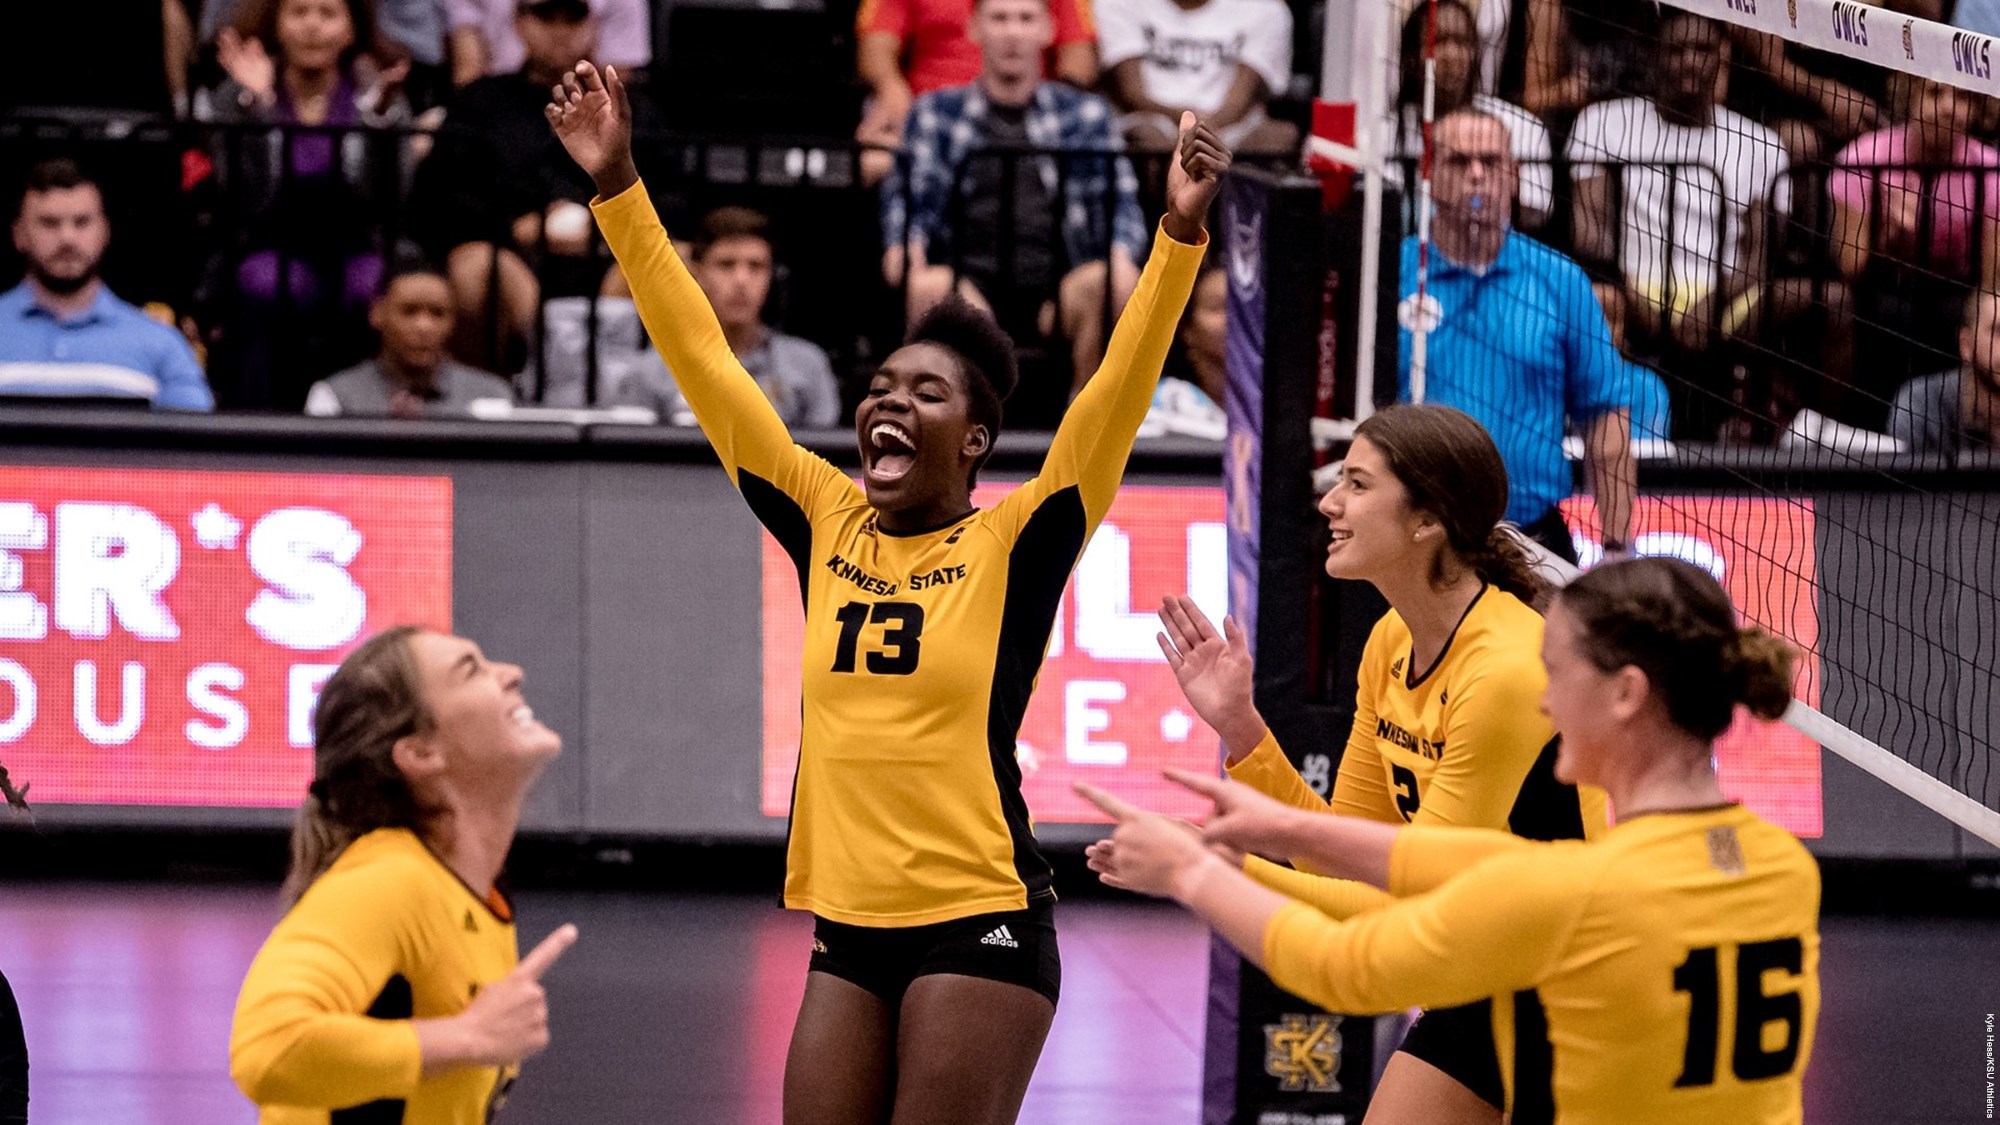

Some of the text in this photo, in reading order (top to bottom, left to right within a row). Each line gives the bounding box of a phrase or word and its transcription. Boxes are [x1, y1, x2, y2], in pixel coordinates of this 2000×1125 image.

[1832, 1, 1868, 47] OWLS
[1952, 31, 1991, 81] OWLS
[910, 563, 966, 591] STATE
[830, 601, 924, 676] 13
[1392, 761, 1420, 823] 2
[980, 936, 1019, 948] adidas
[1673, 936, 1803, 1089] 16
